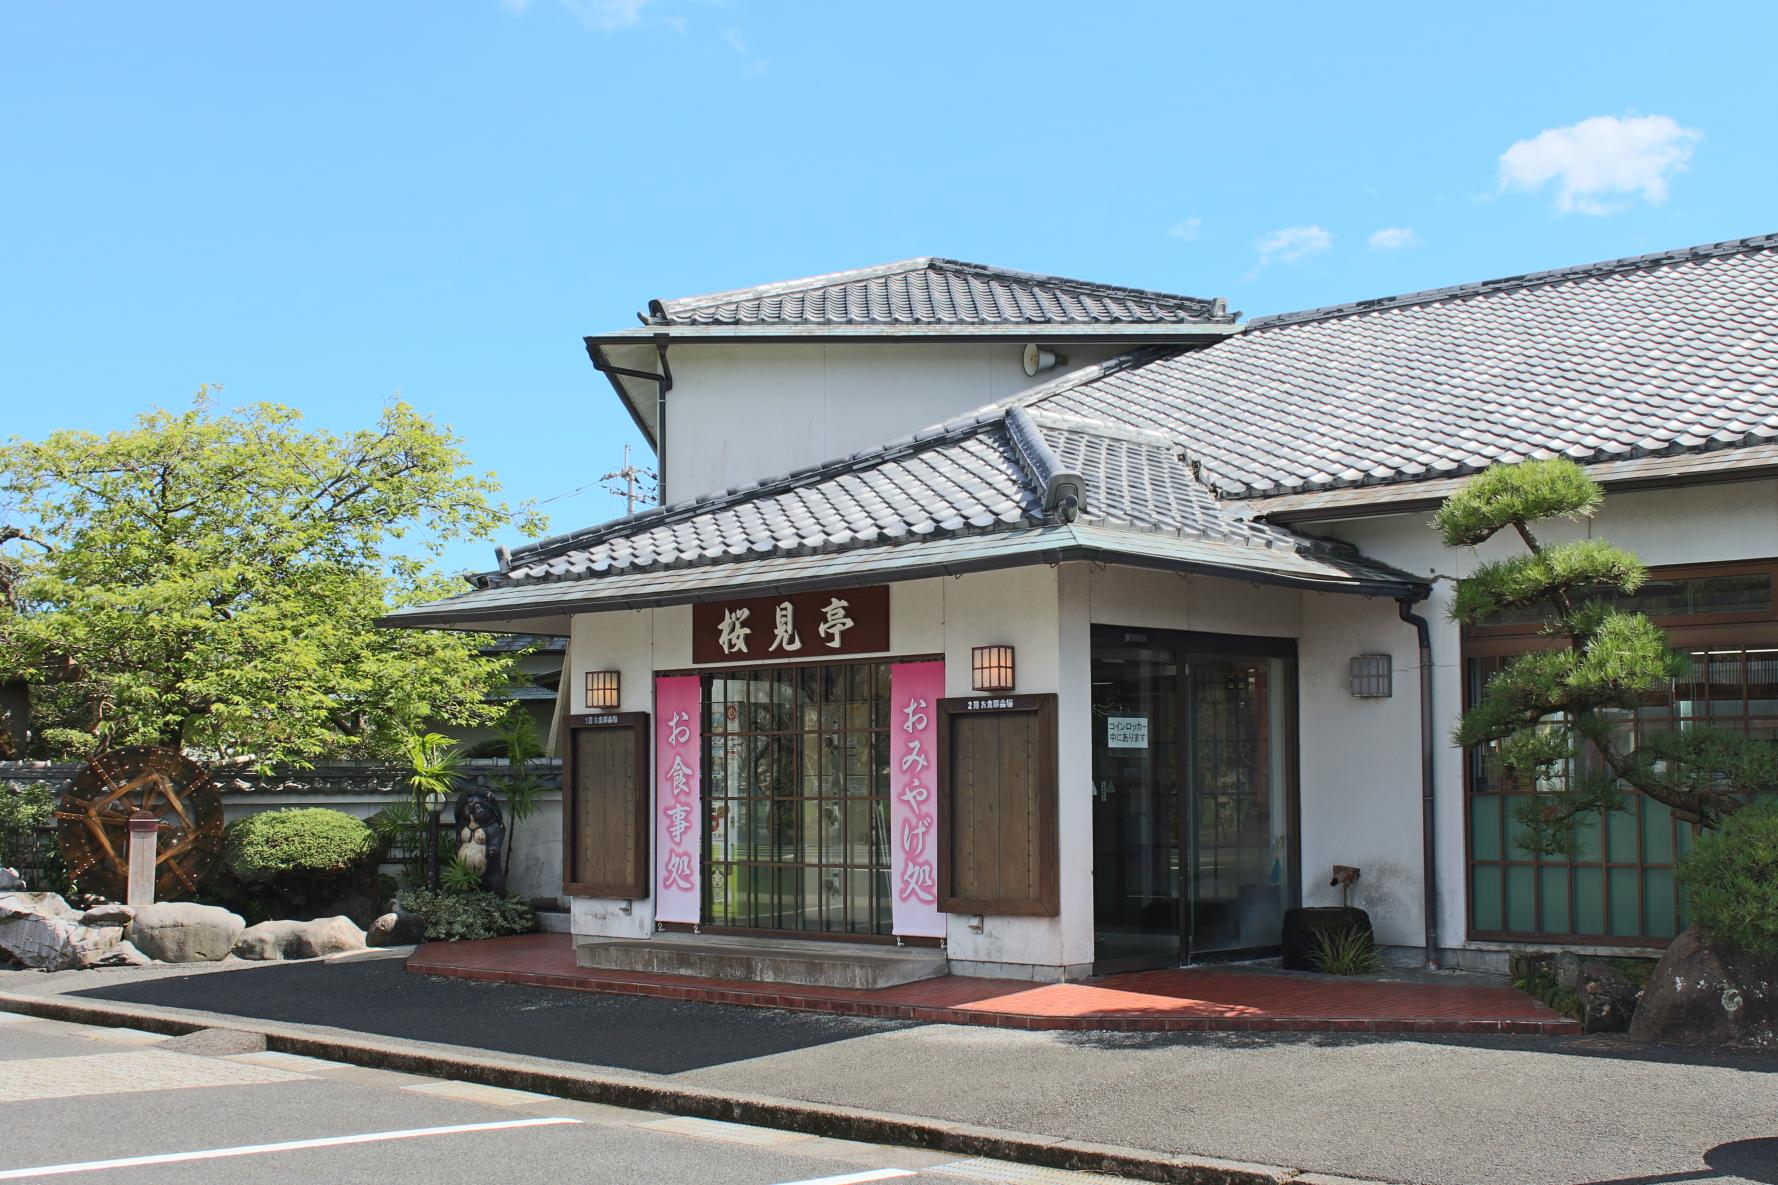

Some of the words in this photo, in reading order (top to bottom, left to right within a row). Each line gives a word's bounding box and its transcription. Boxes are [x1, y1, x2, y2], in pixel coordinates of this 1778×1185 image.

[717, 597, 855, 655] 桜見亭
[1109, 722, 1147, 732] コインロッカー
[1109, 733, 1146, 743] 中にあります
[666, 711, 693, 889] お食事処
[901, 698, 935, 901] おみやげ処
